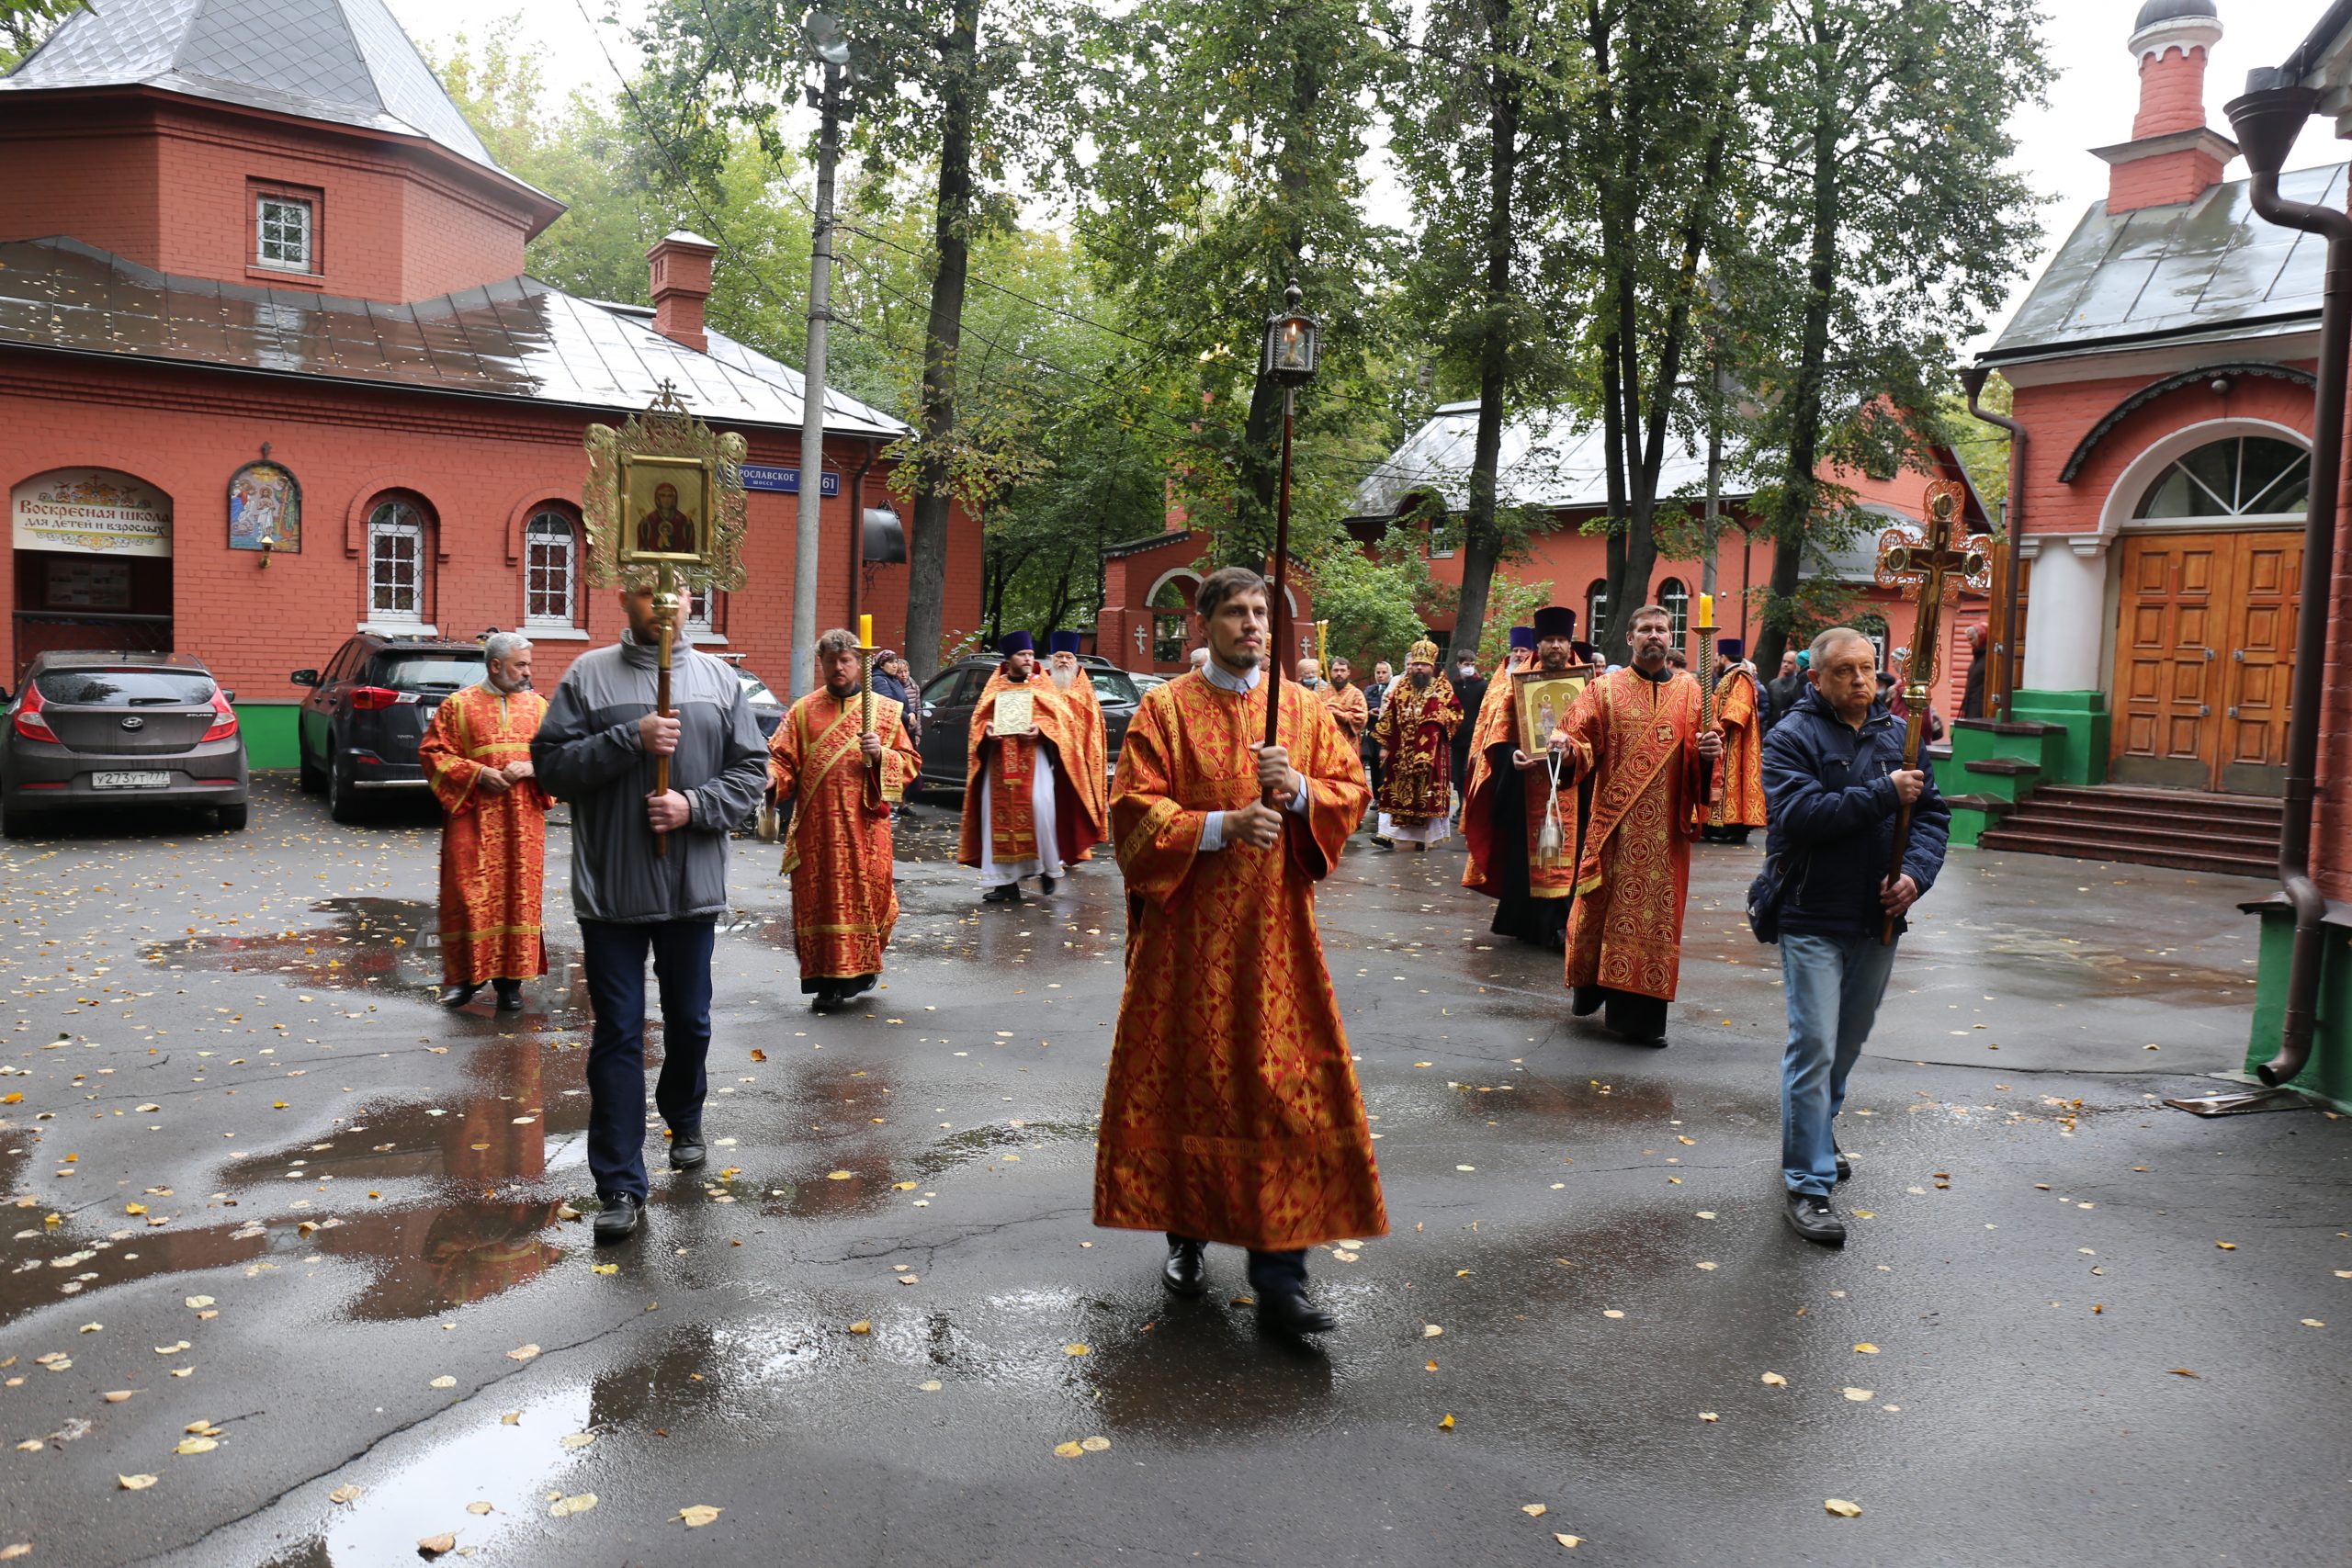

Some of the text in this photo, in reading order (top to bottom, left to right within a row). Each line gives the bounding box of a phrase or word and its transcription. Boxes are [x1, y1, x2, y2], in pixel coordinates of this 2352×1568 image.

[739, 469, 795, 481] РОСЛАВСКОЕ
[822, 478, 834, 489] 61
[148, 772, 166, 780] 777
